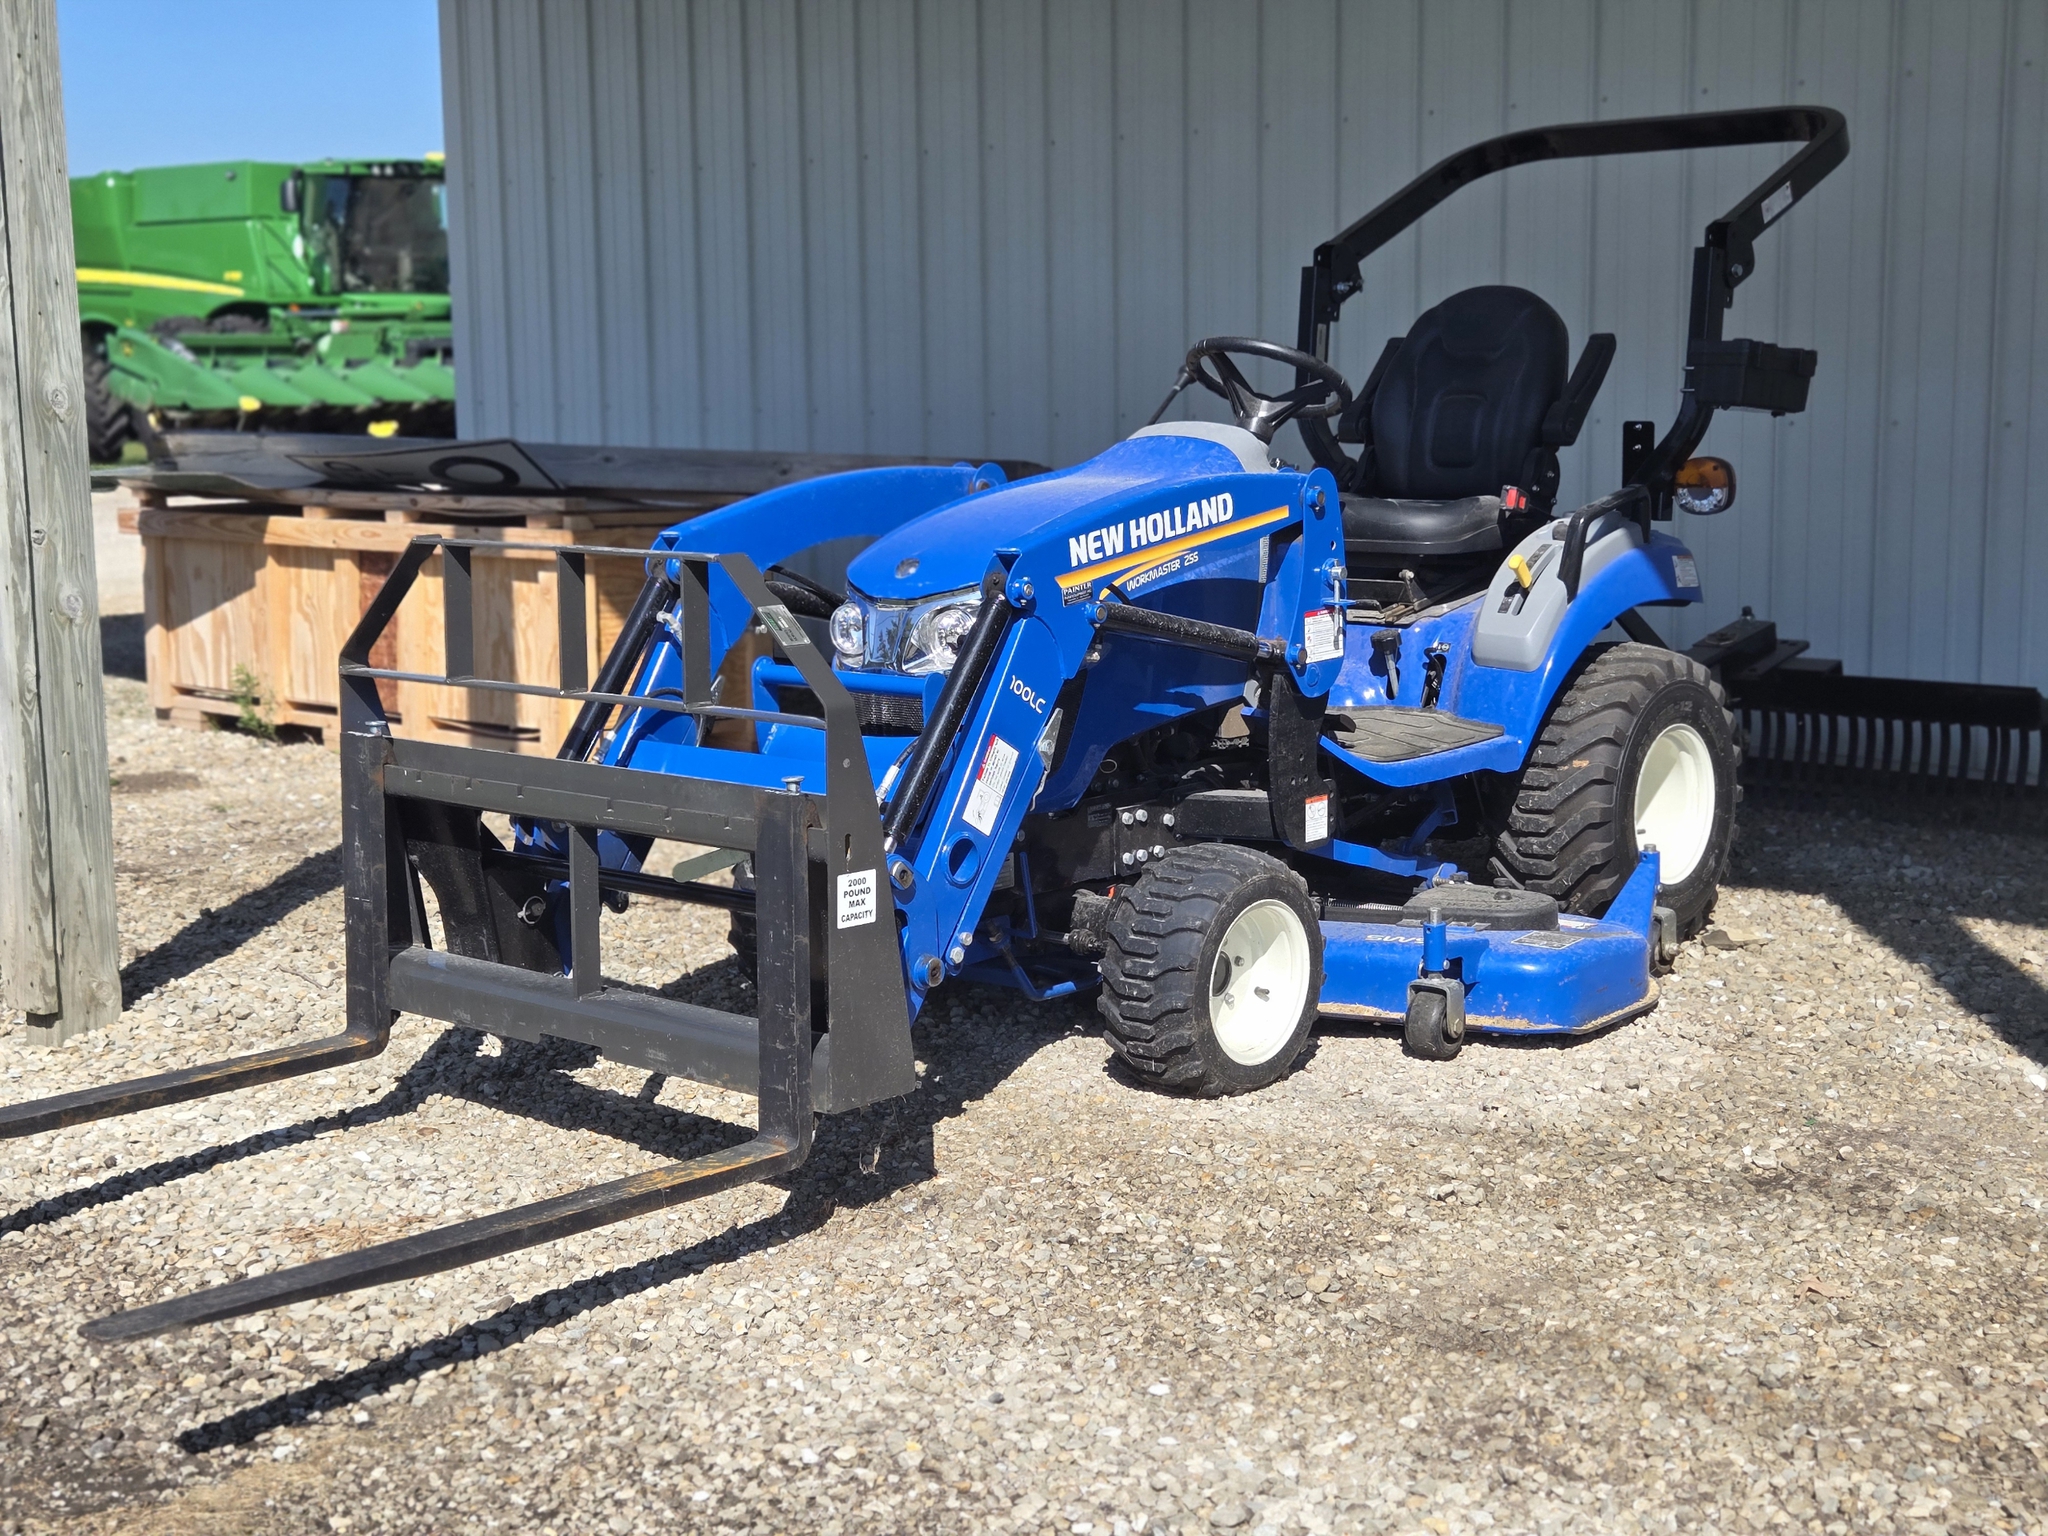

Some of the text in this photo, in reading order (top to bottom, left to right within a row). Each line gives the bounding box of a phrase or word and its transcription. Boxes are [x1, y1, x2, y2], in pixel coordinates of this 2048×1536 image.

[1069, 492, 1234, 567] NEW HOLLAND
[1126, 559, 1181, 592] WORKMASTER
[1063, 581, 1092, 596] PAINTER
[1010, 675, 1046, 714] 100LC
[848, 877, 867, 887] 2000
[843, 887, 872, 898] POUND
[848, 898, 867, 908] MAX
[841, 909, 873, 922] CAPACITY
